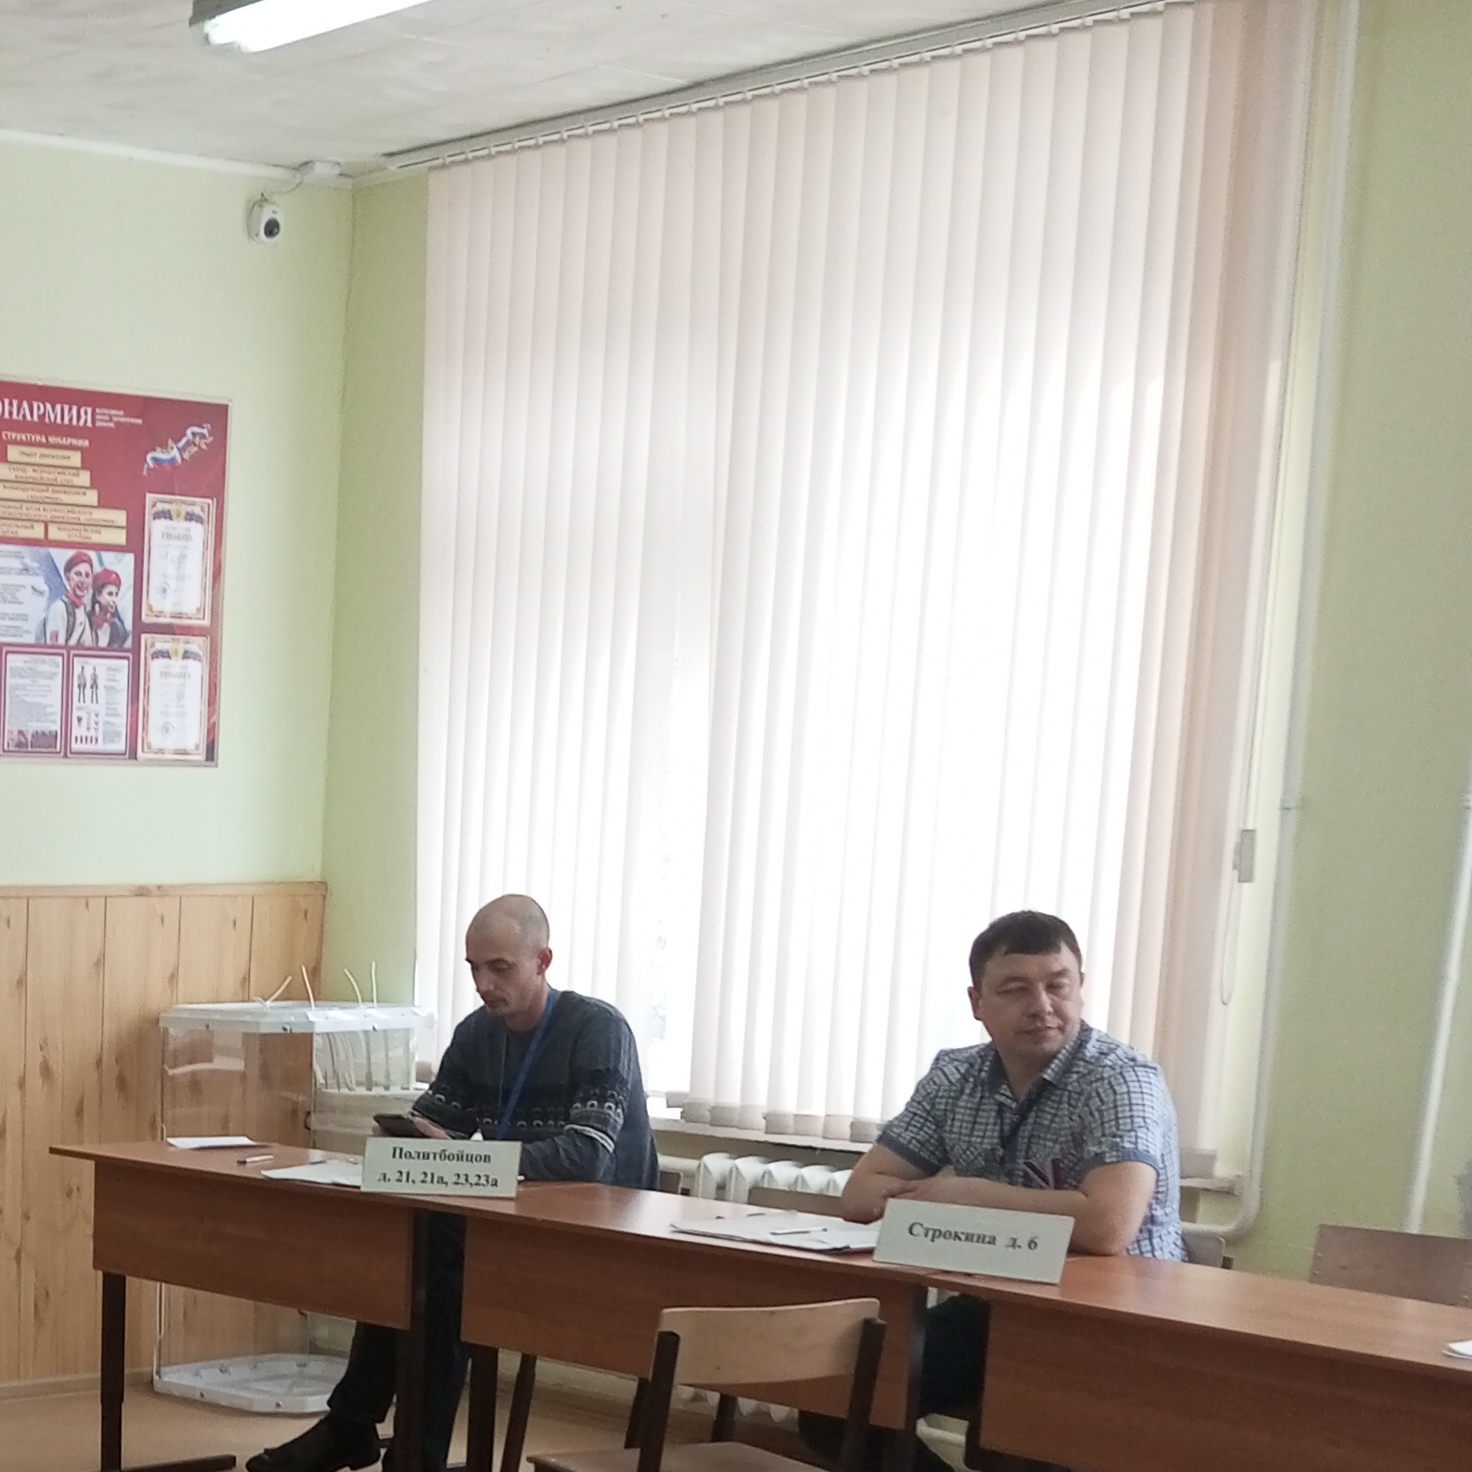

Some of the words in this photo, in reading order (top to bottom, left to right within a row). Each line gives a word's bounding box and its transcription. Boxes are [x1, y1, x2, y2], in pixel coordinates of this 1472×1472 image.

[2, 431, 47, 444] СТРУКТУРА
[391, 1146, 491, 1164] Политбойцов
[377, 1172, 391, 1183] д.
[395, 1170, 416, 1184] 21,
[907, 1222, 997, 1247] Строкина
[1005, 1236, 1022, 1250] д.
[1027, 1236, 1039, 1251] 6
